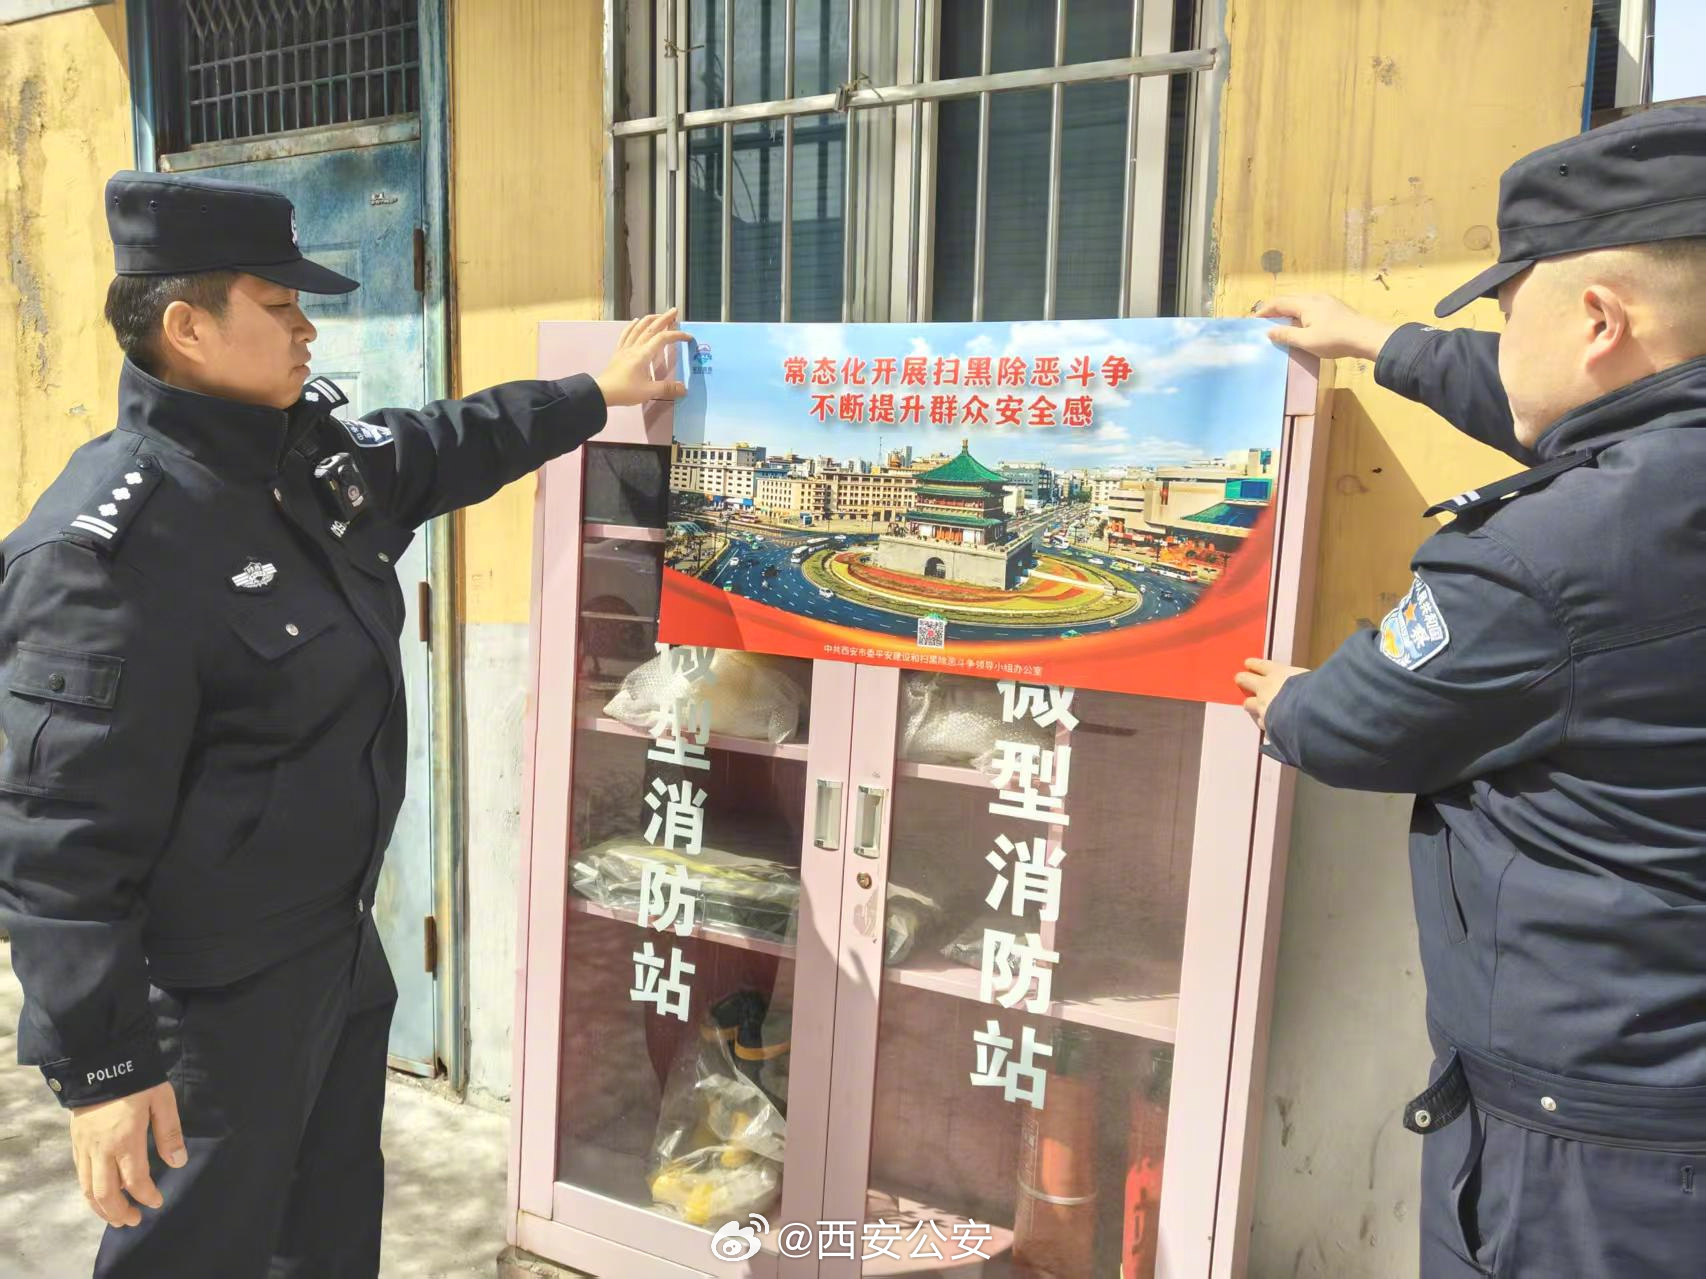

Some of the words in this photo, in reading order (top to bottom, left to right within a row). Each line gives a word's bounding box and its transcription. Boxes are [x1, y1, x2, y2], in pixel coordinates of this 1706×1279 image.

[783, 355, 1133, 388] 常态化开展扫黑除恶斗争
[809, 393, 1094, 427] 不断提升群众安全感
[86, 1060, 135, 1085] POLICE
